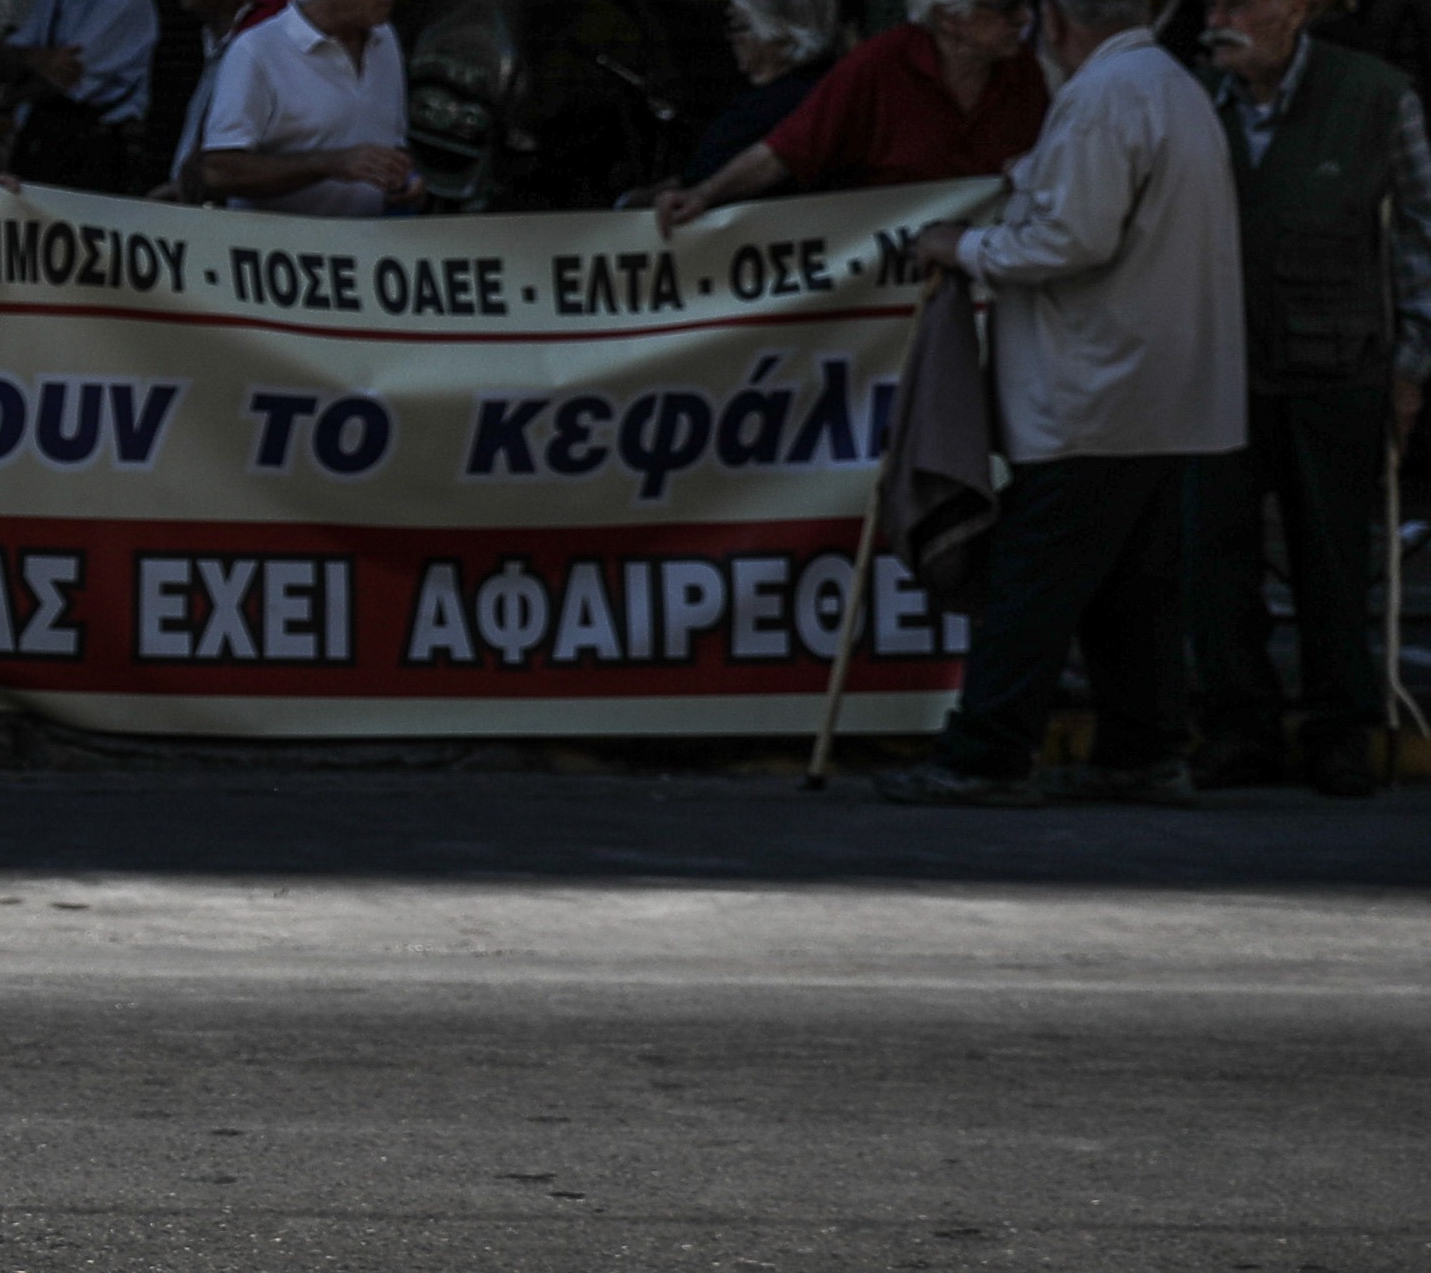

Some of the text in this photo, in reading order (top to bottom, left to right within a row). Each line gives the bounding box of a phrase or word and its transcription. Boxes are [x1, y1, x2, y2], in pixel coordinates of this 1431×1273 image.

[231, 246, 361, 312] ΠΟΣΕ
[373, 257, 507, 315] ΟΑΕΕ
[554, 250, 684, 316] ΕΛΤΑ
[729, 237, 832, 300] ΟΣΕ
[249, 390, 392, 474] το
[136, 555, 353, 663] ΕΧΕΙ
